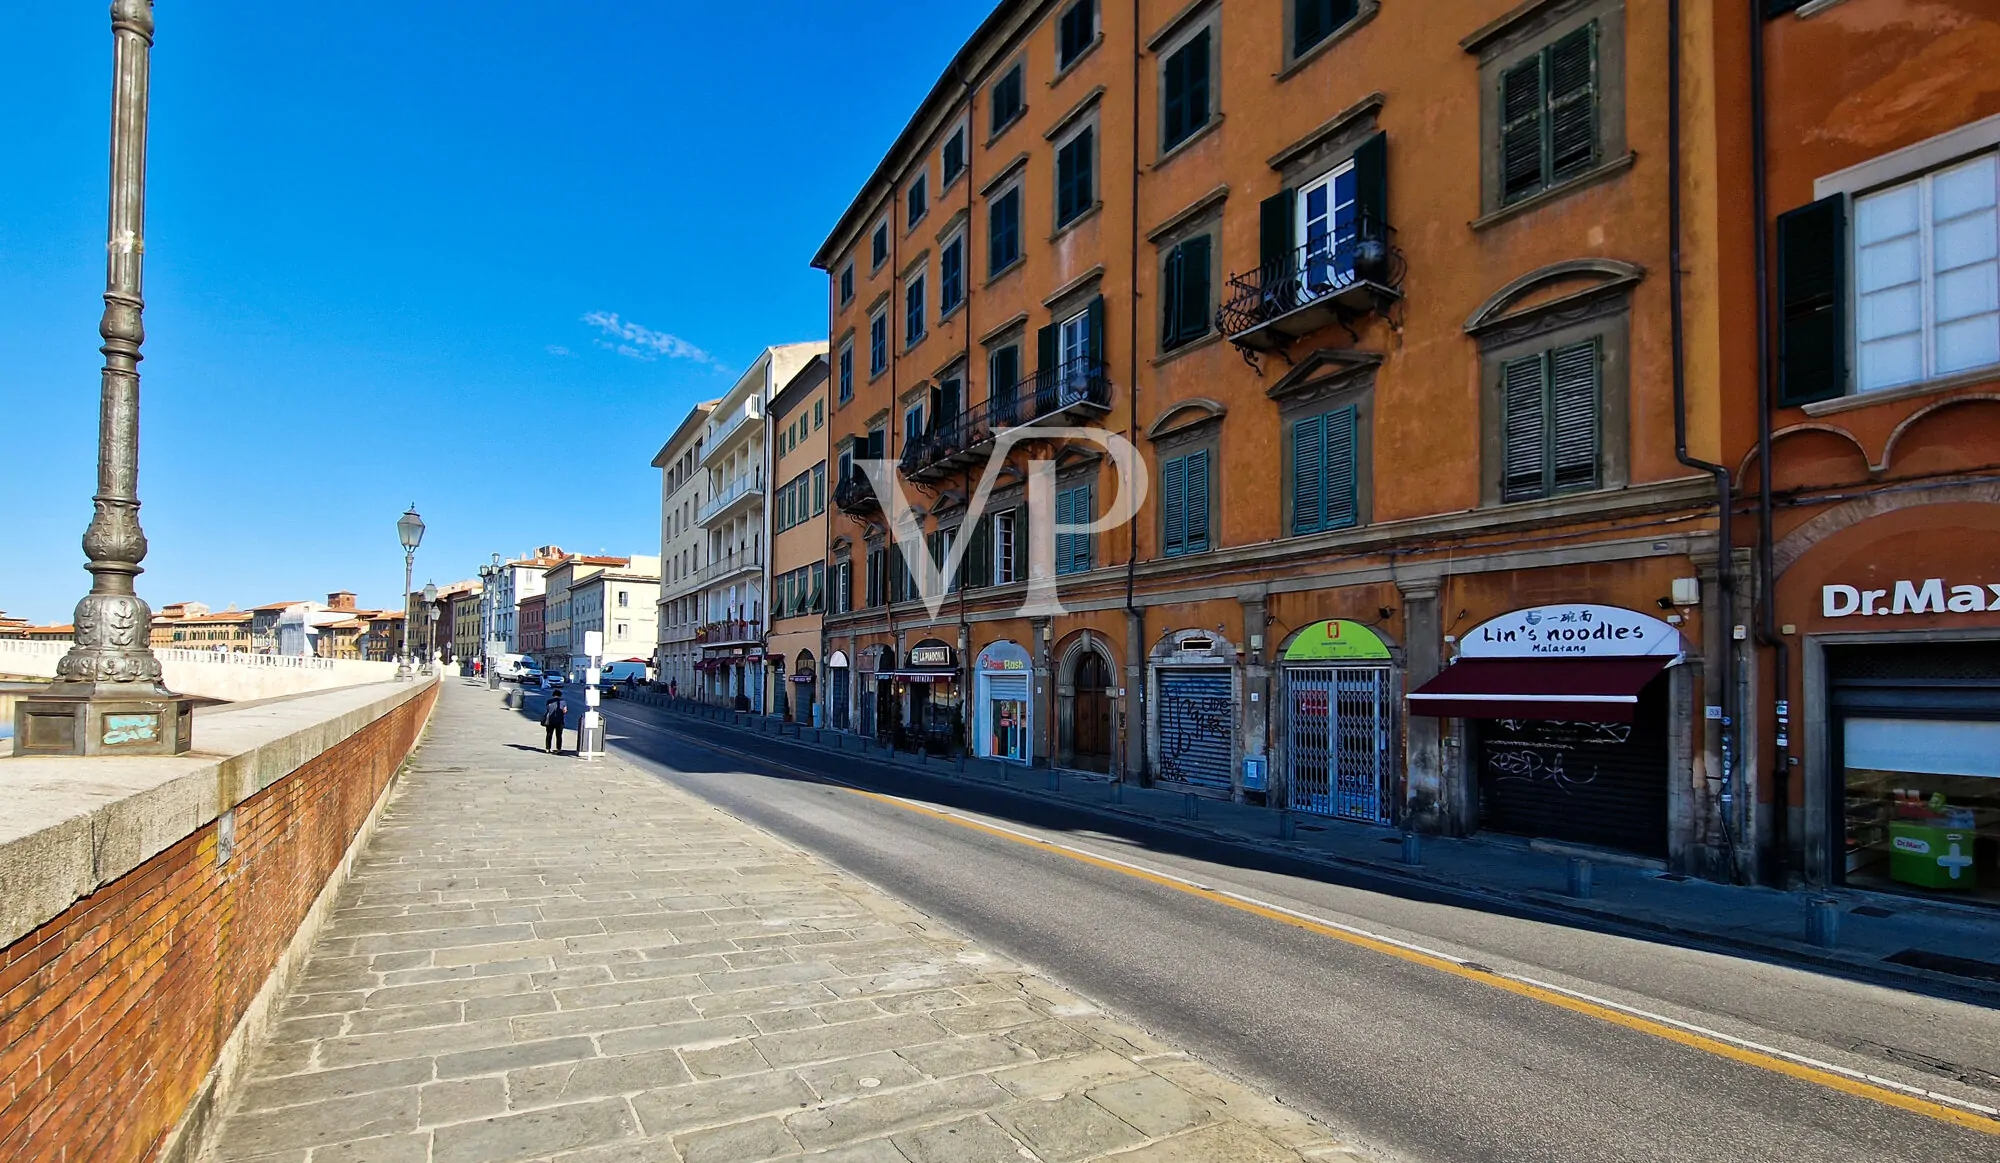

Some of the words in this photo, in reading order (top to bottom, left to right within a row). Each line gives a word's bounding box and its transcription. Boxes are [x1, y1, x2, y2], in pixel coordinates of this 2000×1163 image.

[1484, 626, 1538, 642] Lin's
[1547, 622, 1644, 641] noodles
[1532, 643, 1586, 653] Malatang
